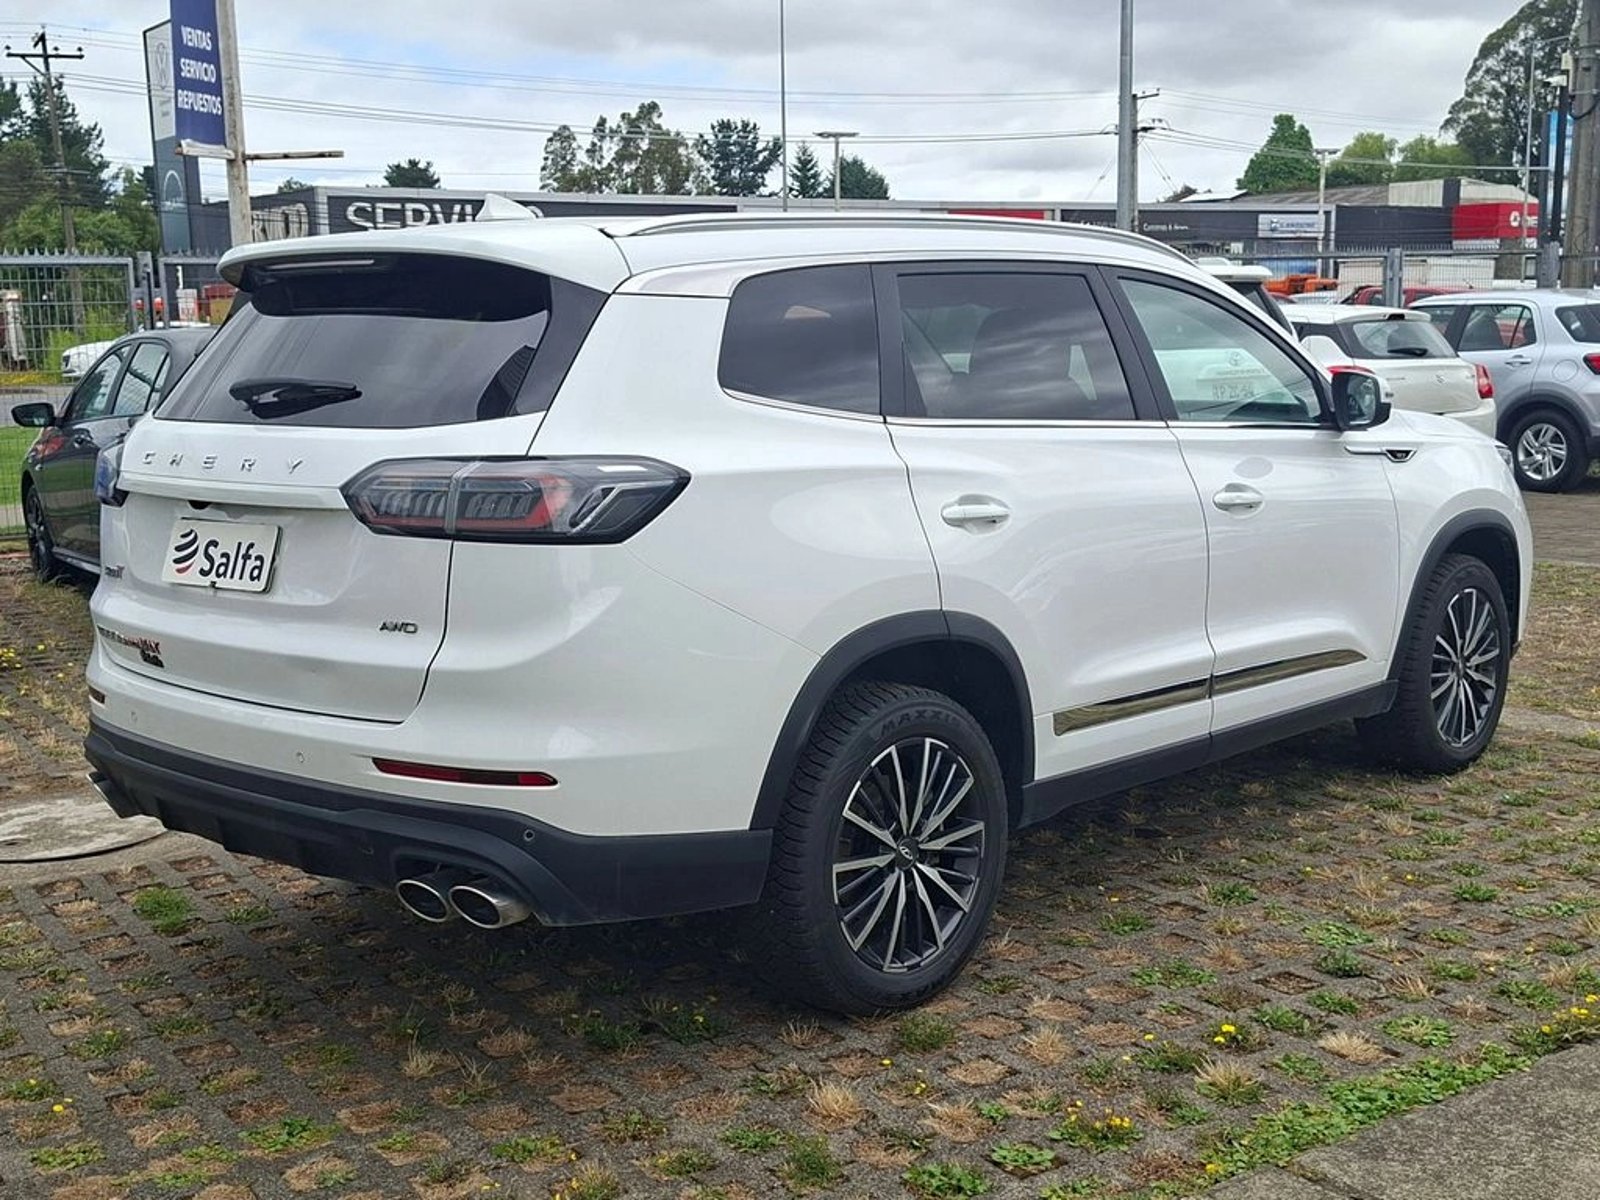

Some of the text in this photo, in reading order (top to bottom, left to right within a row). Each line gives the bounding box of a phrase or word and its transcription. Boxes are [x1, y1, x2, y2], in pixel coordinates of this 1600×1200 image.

[180, 25, 212, 51] VENTAS
[180, 57, 217, 84] SERVICIO
[177, 89, 222, 115] REPUESTOS
[346, 201, 544, 231] SERVI
[142, 450, 303, 474] CHERY
[198, 539, 266, 582] Salfa
[379, 621, 418, 634] AWD
